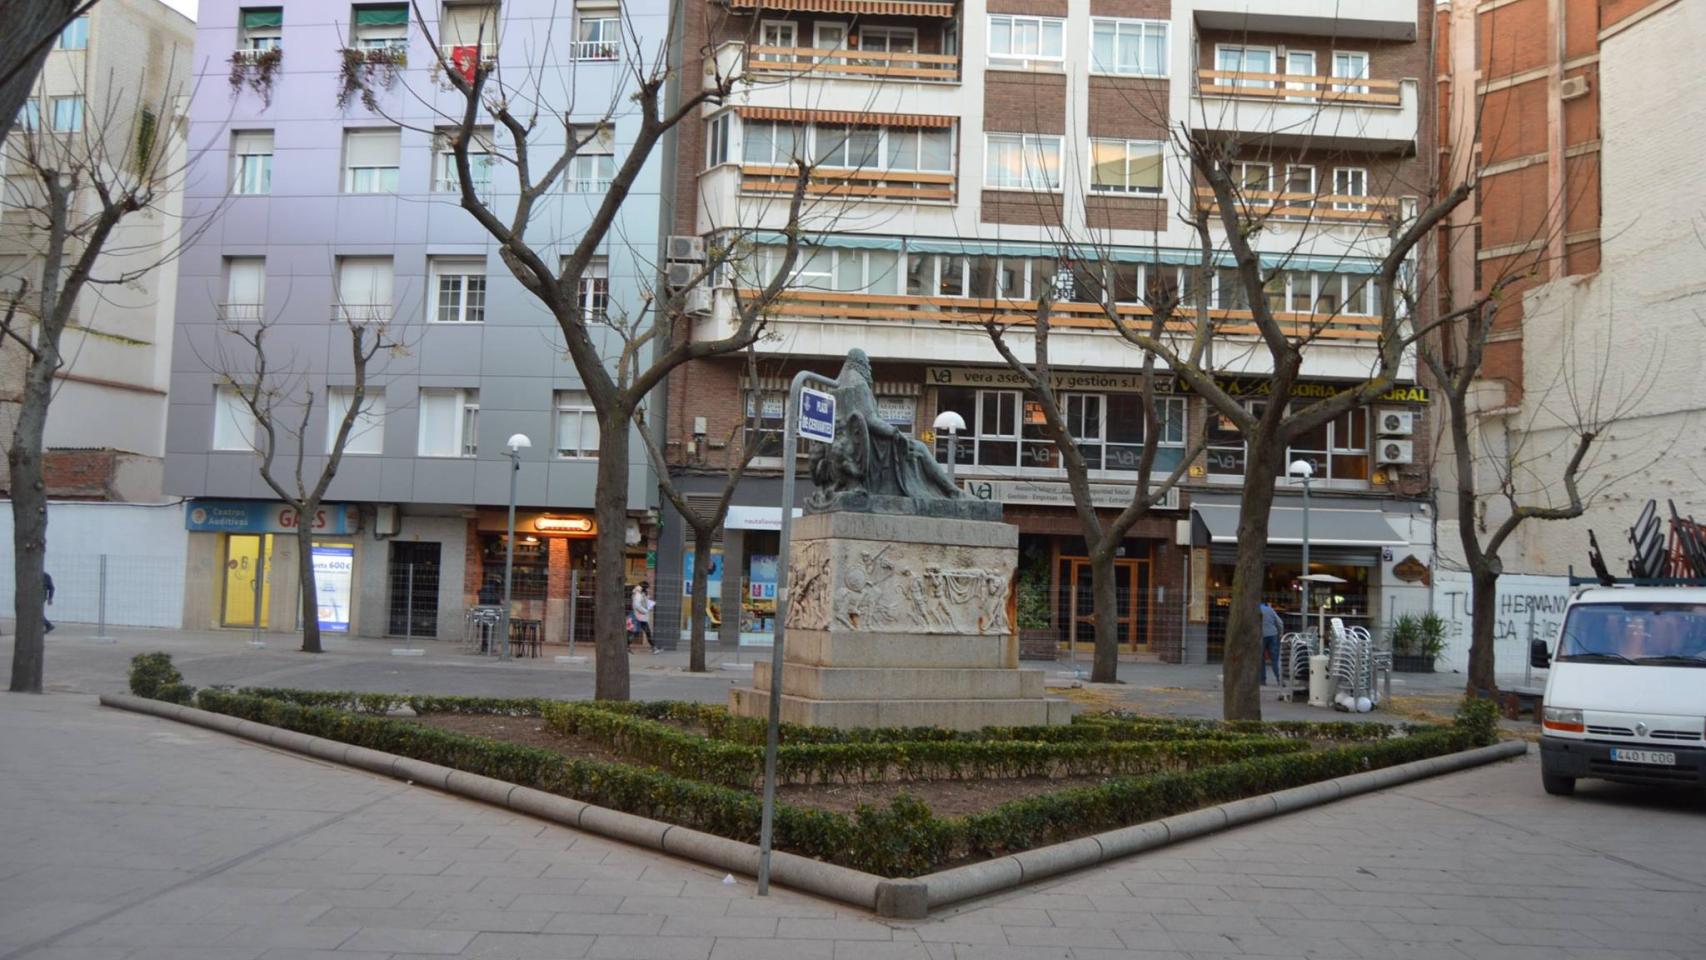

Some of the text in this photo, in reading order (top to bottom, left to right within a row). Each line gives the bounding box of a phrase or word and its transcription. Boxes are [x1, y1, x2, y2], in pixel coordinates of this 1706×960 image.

[964, 373, 992, 382] vera
[1056, 377, 1063, 386] y
[1068, 375, 1117, 388] gestión
[968, 482, 992, 500] va
[279, 508, 326, 528] GAS
[1618, 750, 1646, 761] 4401
